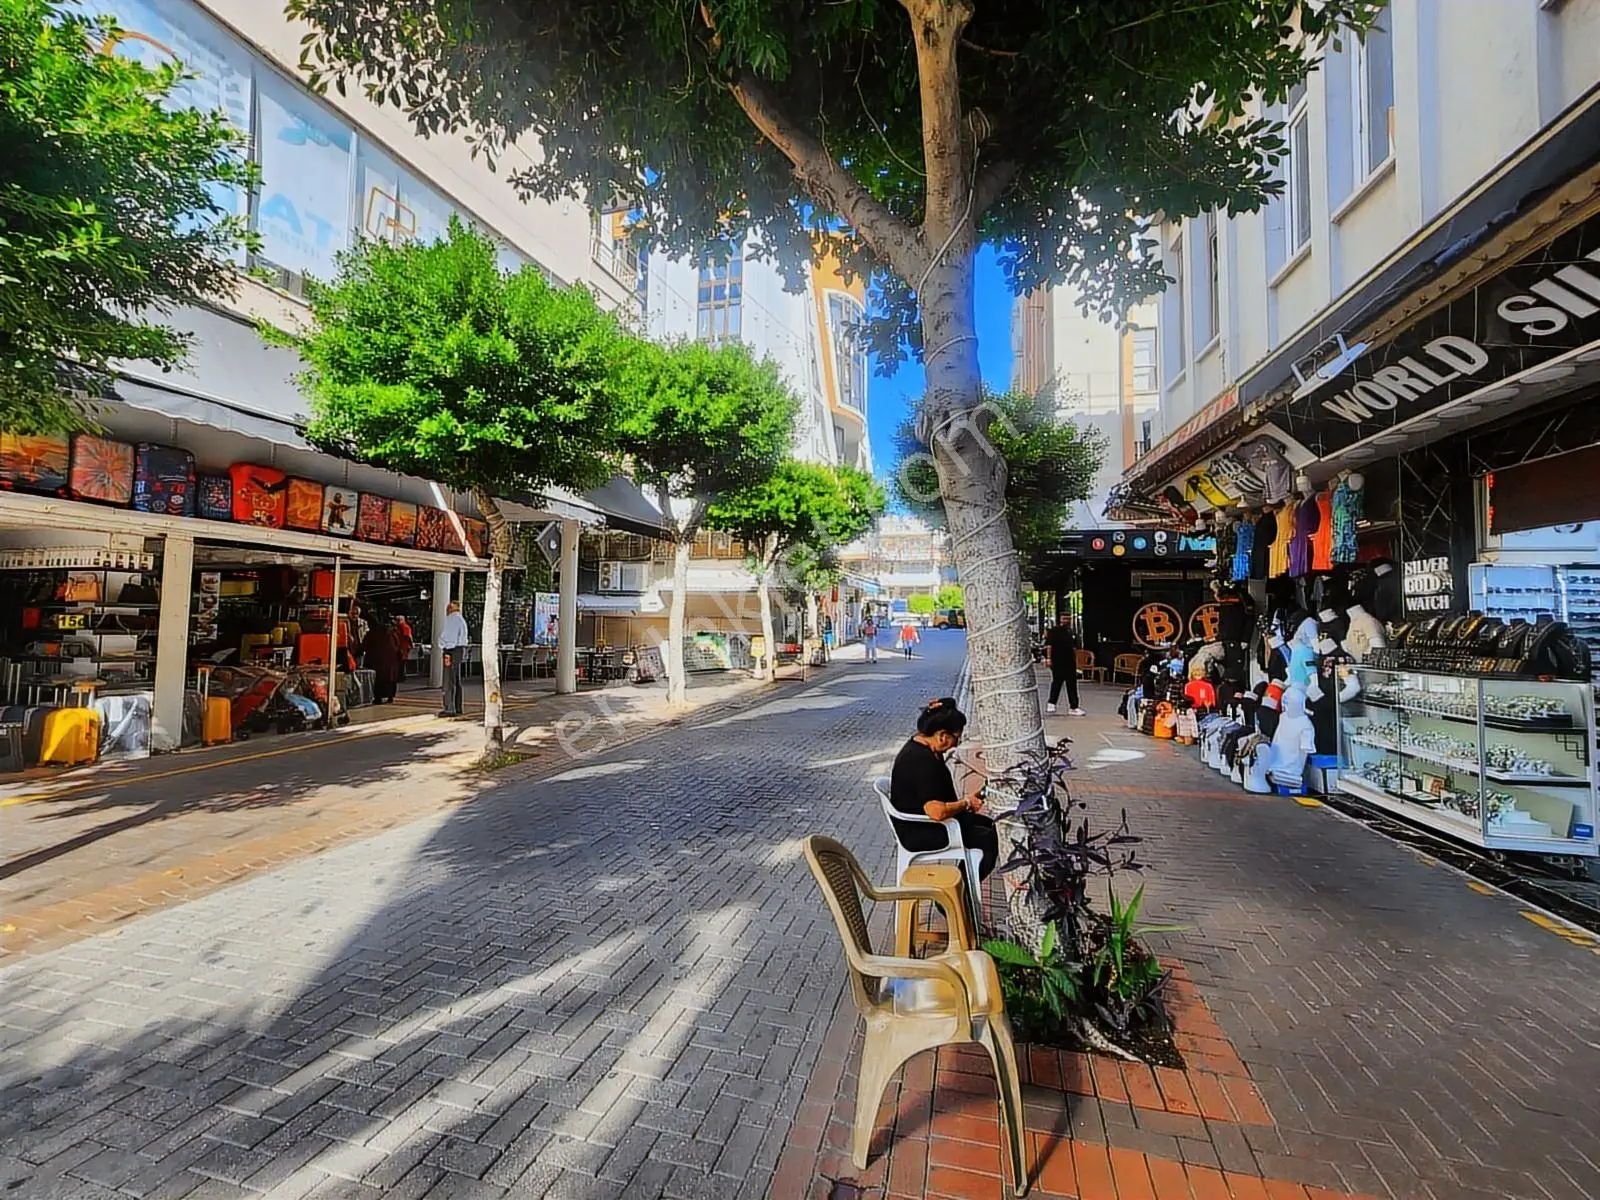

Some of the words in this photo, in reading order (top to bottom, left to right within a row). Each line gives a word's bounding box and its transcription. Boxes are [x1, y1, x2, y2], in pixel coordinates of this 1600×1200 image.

[1321, 335, 1489, 424] WORLD
[1404, 556, 1449, 575] SILVER
[1405, 575, 1441, 593] GOLD
[1406, 595, 1450, 610] WATCH
